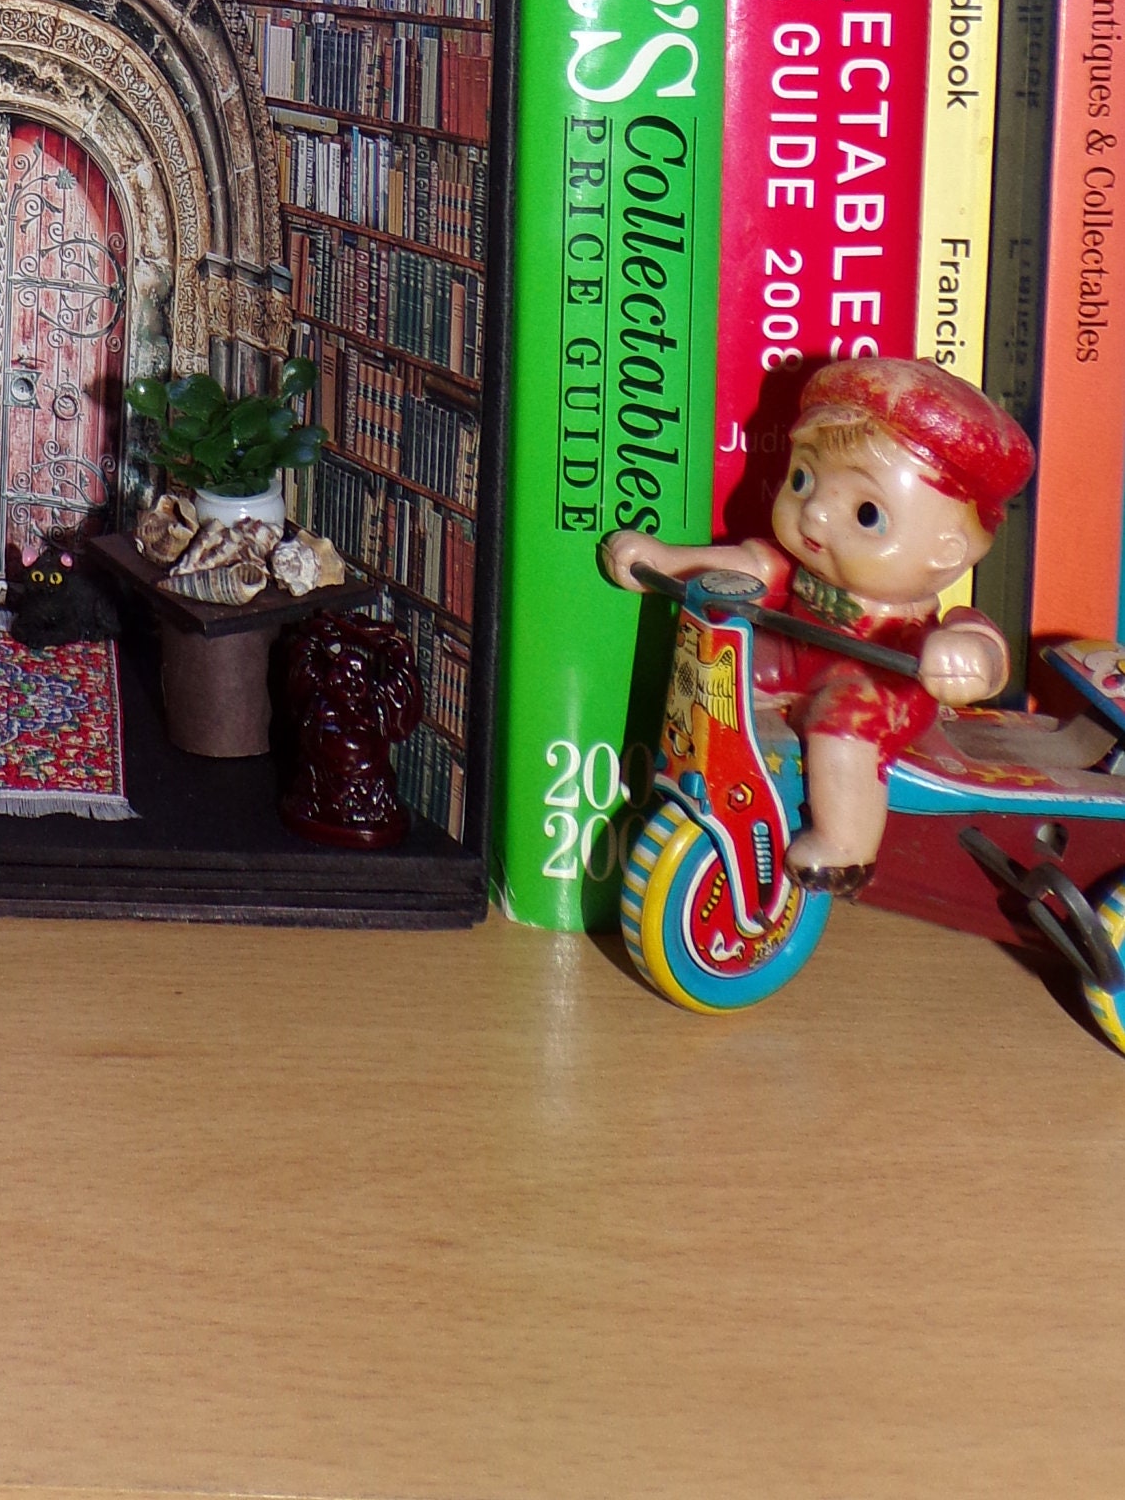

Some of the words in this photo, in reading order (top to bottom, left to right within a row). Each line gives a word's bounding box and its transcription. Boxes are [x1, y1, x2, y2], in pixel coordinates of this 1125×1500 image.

[767, 22, 822, 209] GUIDE
[1085, 127, 1117, 156] &
[566, 115, 608, 306] PRICE
[935, 236, 971, 366] Francis
[1076, 166, 1116, 365] Collectables
[614, 114, 689, 536] Collectables
[761, 248, 804, 373] 2008
[560, 336, 603, 533] GUIDE
